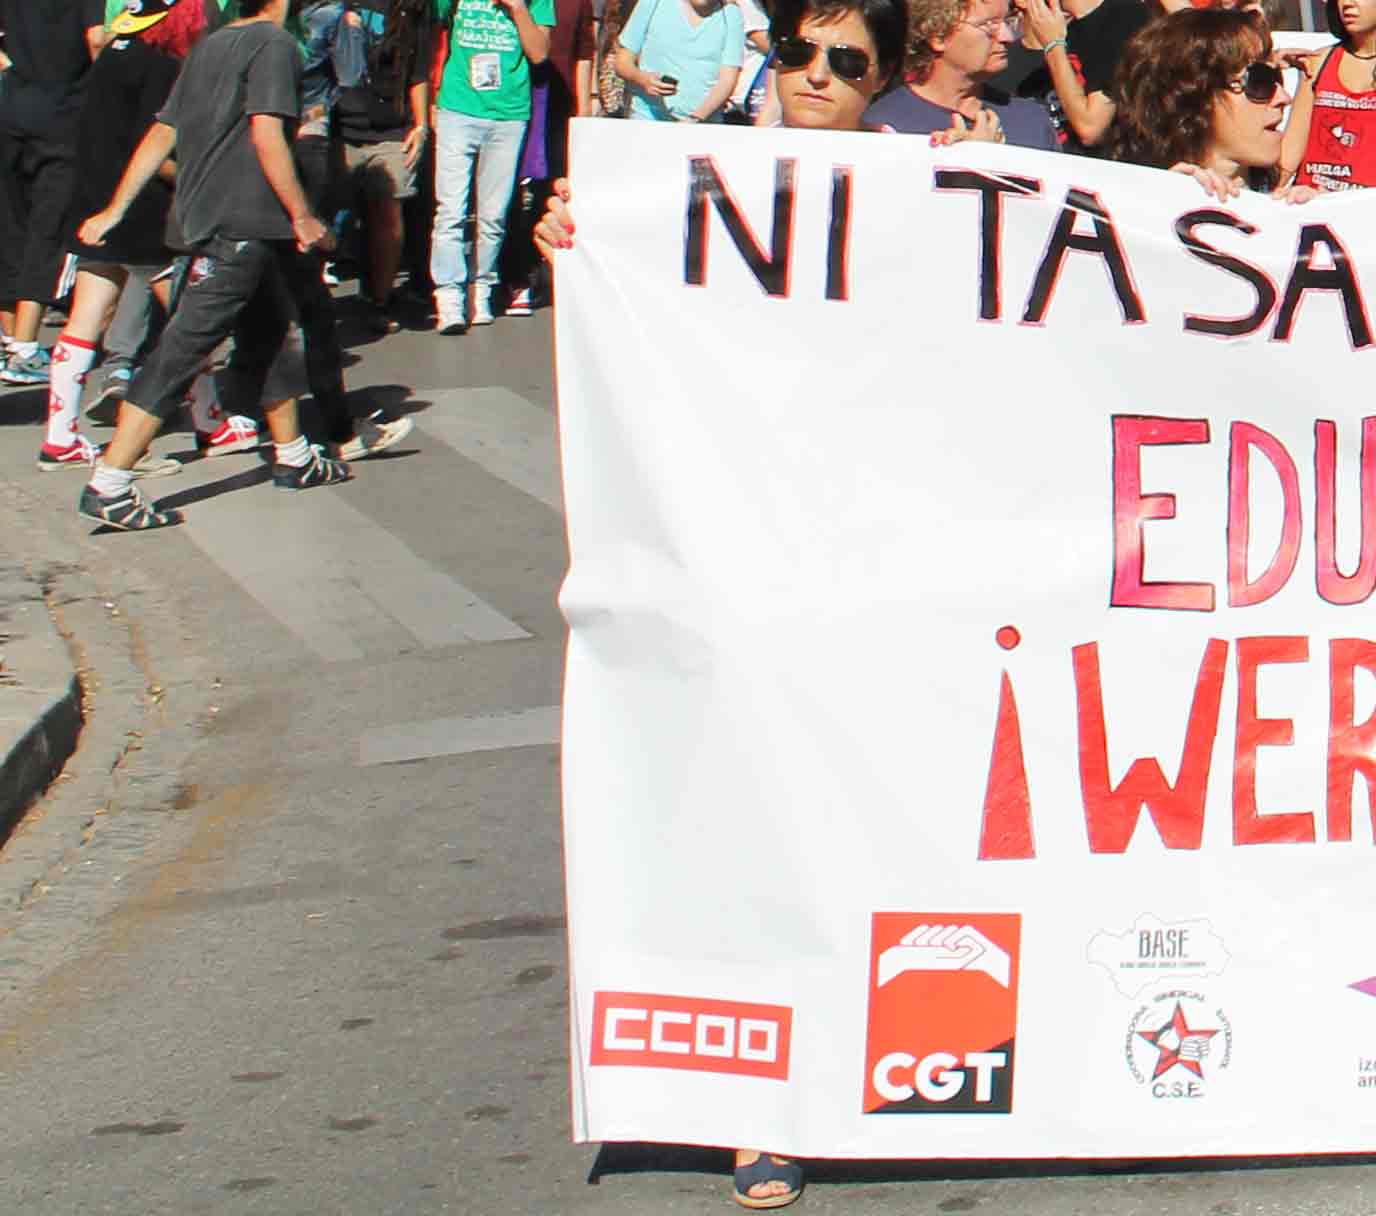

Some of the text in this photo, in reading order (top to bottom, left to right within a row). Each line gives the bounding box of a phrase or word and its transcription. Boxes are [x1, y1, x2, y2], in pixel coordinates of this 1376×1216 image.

[683, 152, 853, 301] NI
[1138, 929, 1189, 959] BASE
[603, 1007, 778, 1063] CCOO
[872, 1051, 1006, 1103] CGT
